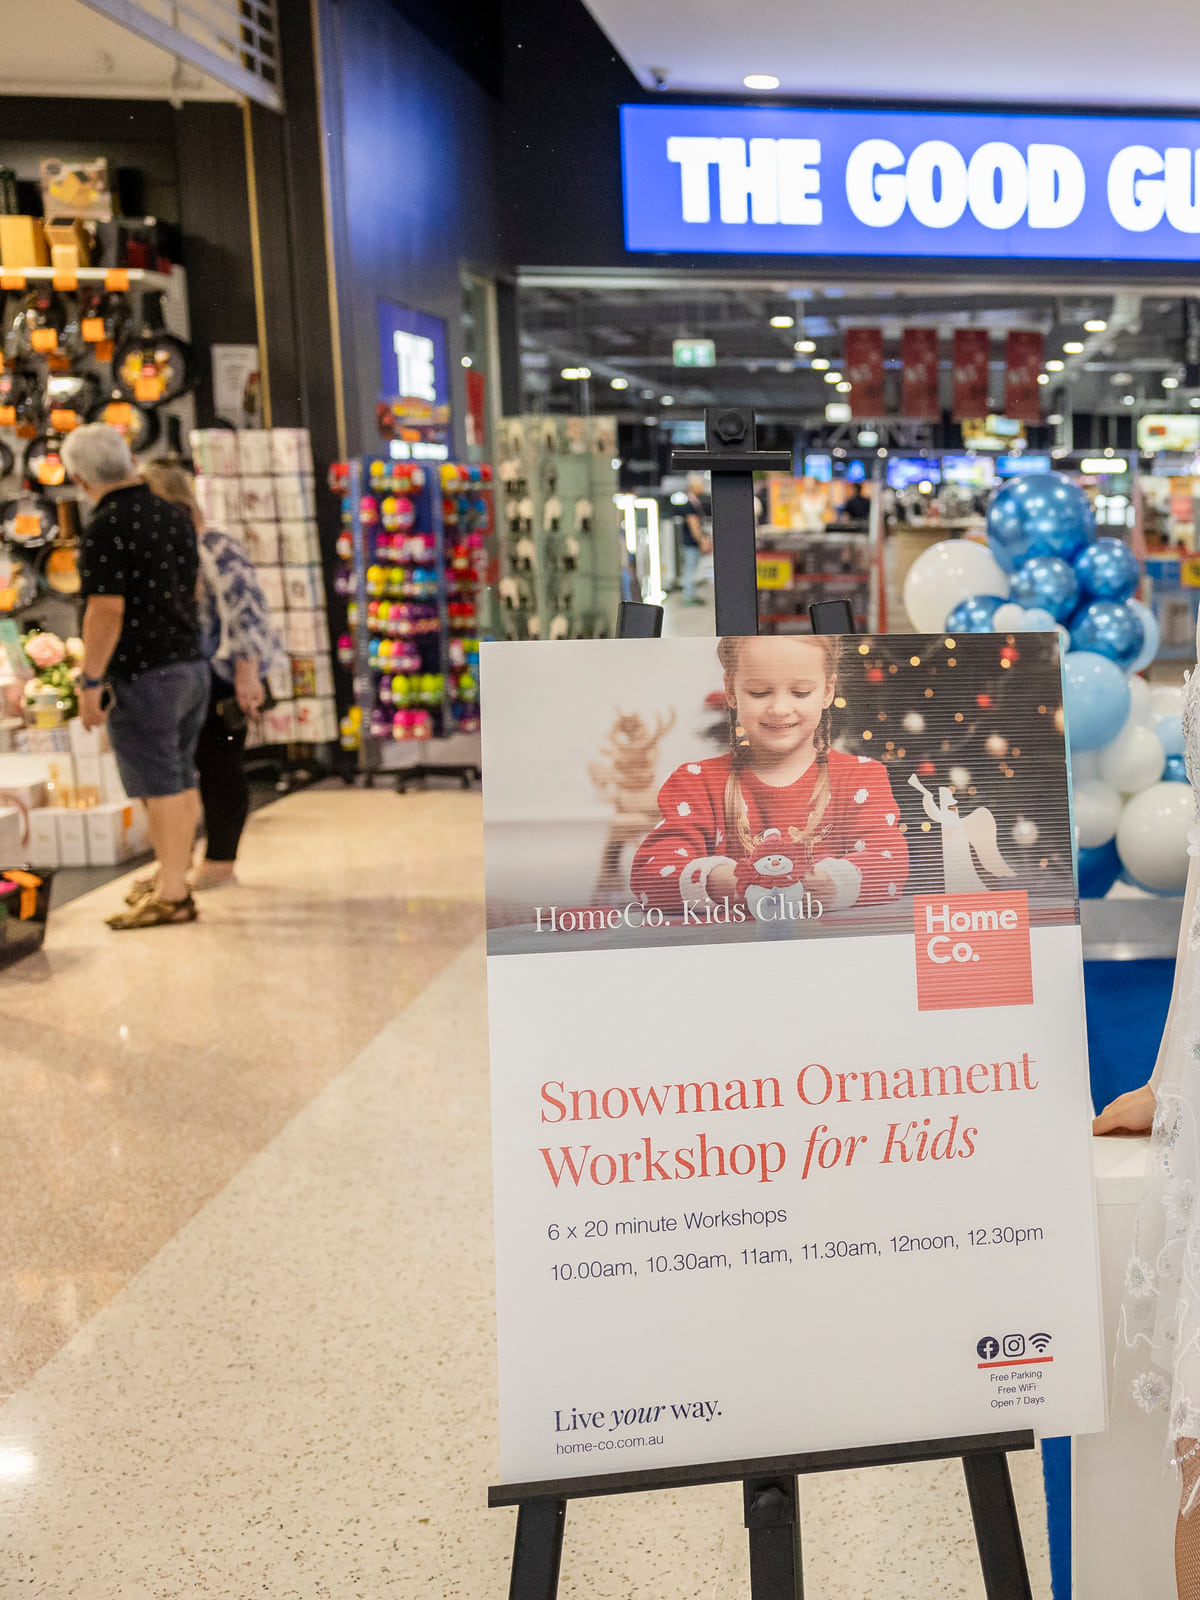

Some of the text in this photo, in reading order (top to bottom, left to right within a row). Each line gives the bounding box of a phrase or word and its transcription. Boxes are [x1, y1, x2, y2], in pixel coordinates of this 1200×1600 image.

[667, 136, 823, 225] THE
[845, 139, 1086, 230] GOOD
[533, 892, 824, 933] HomeCo. Kids Club
[925, 902, 1019, 935] Home
[926, 934, 981, 964] Co.
[540, 1052, 1039, 1124] Snowman Ornament
[538, 1114, 979, 1189] Workshop for Kids
[547, 1208, 788, 1241] 6 x 20 minute Workshops
[551, 1226, 1044, 1281] 10.00am, 10.30am, 11am, 11.30am, 12noon, 12.30pm
[990, 1370, 1043, 1382] Free Parking
[997, 1382, 1036, 1394] Free WiFi
[554, 1400, 723, 1432] Live your way.
[990, 1396, 1045, 1408] Open 7 Days
[556, 1435, 664, 1455] home-co.com.au
